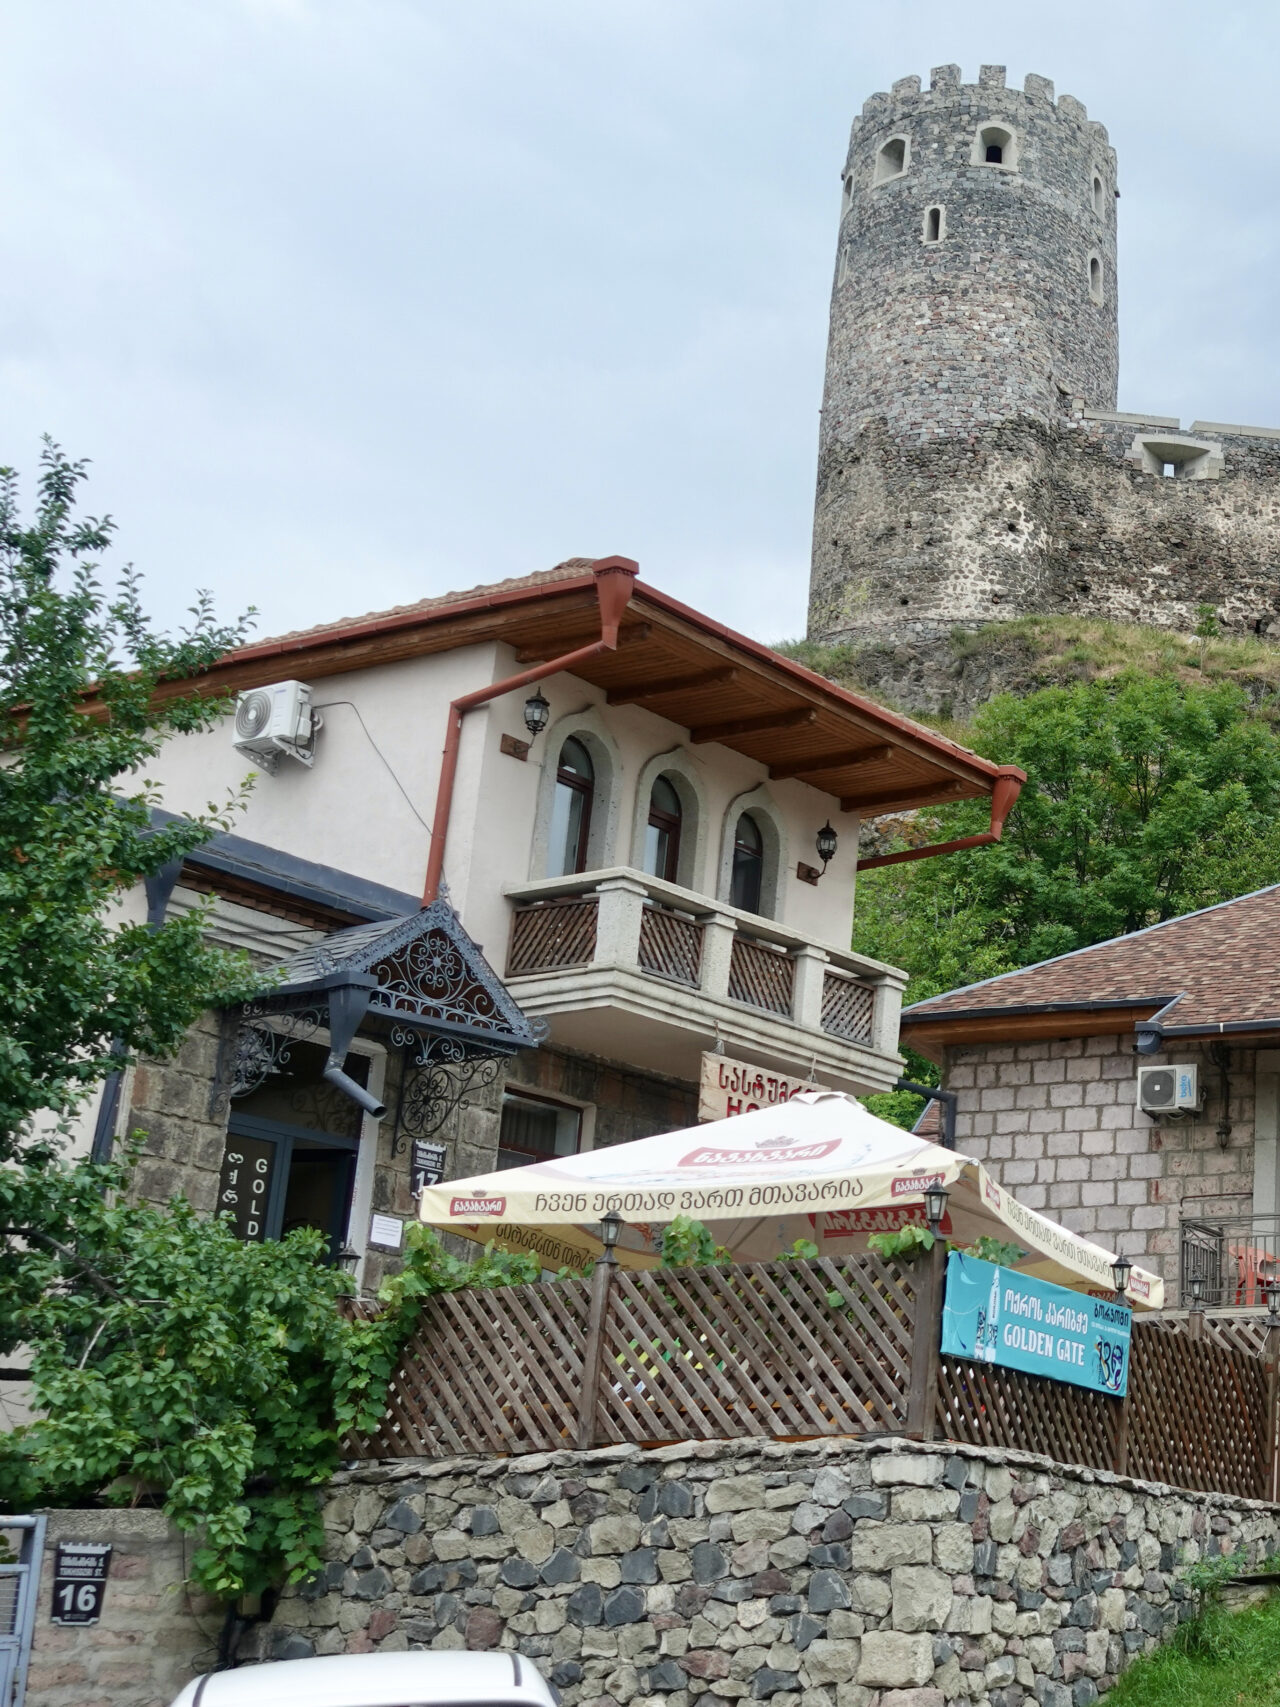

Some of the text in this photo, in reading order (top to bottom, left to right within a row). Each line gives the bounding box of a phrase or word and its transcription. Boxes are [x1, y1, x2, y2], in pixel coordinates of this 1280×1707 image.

[719, 1063, 816, 1103] სასტუმ
[416, 1170, 439, 1193] 17
[535, 1178, 864, 1212] ჩვენ ერთად ვართ მთავარია
[1004, 1289, 1043, 1322] ოქროს
[1045, 1302, 1089, 1334] კარიბჭე
[1004, 1323, 1053, 1358] GOLDEN
[1057, 1338, 1086, 1366] GATE
[59, 1584, 97, 1611] 16
